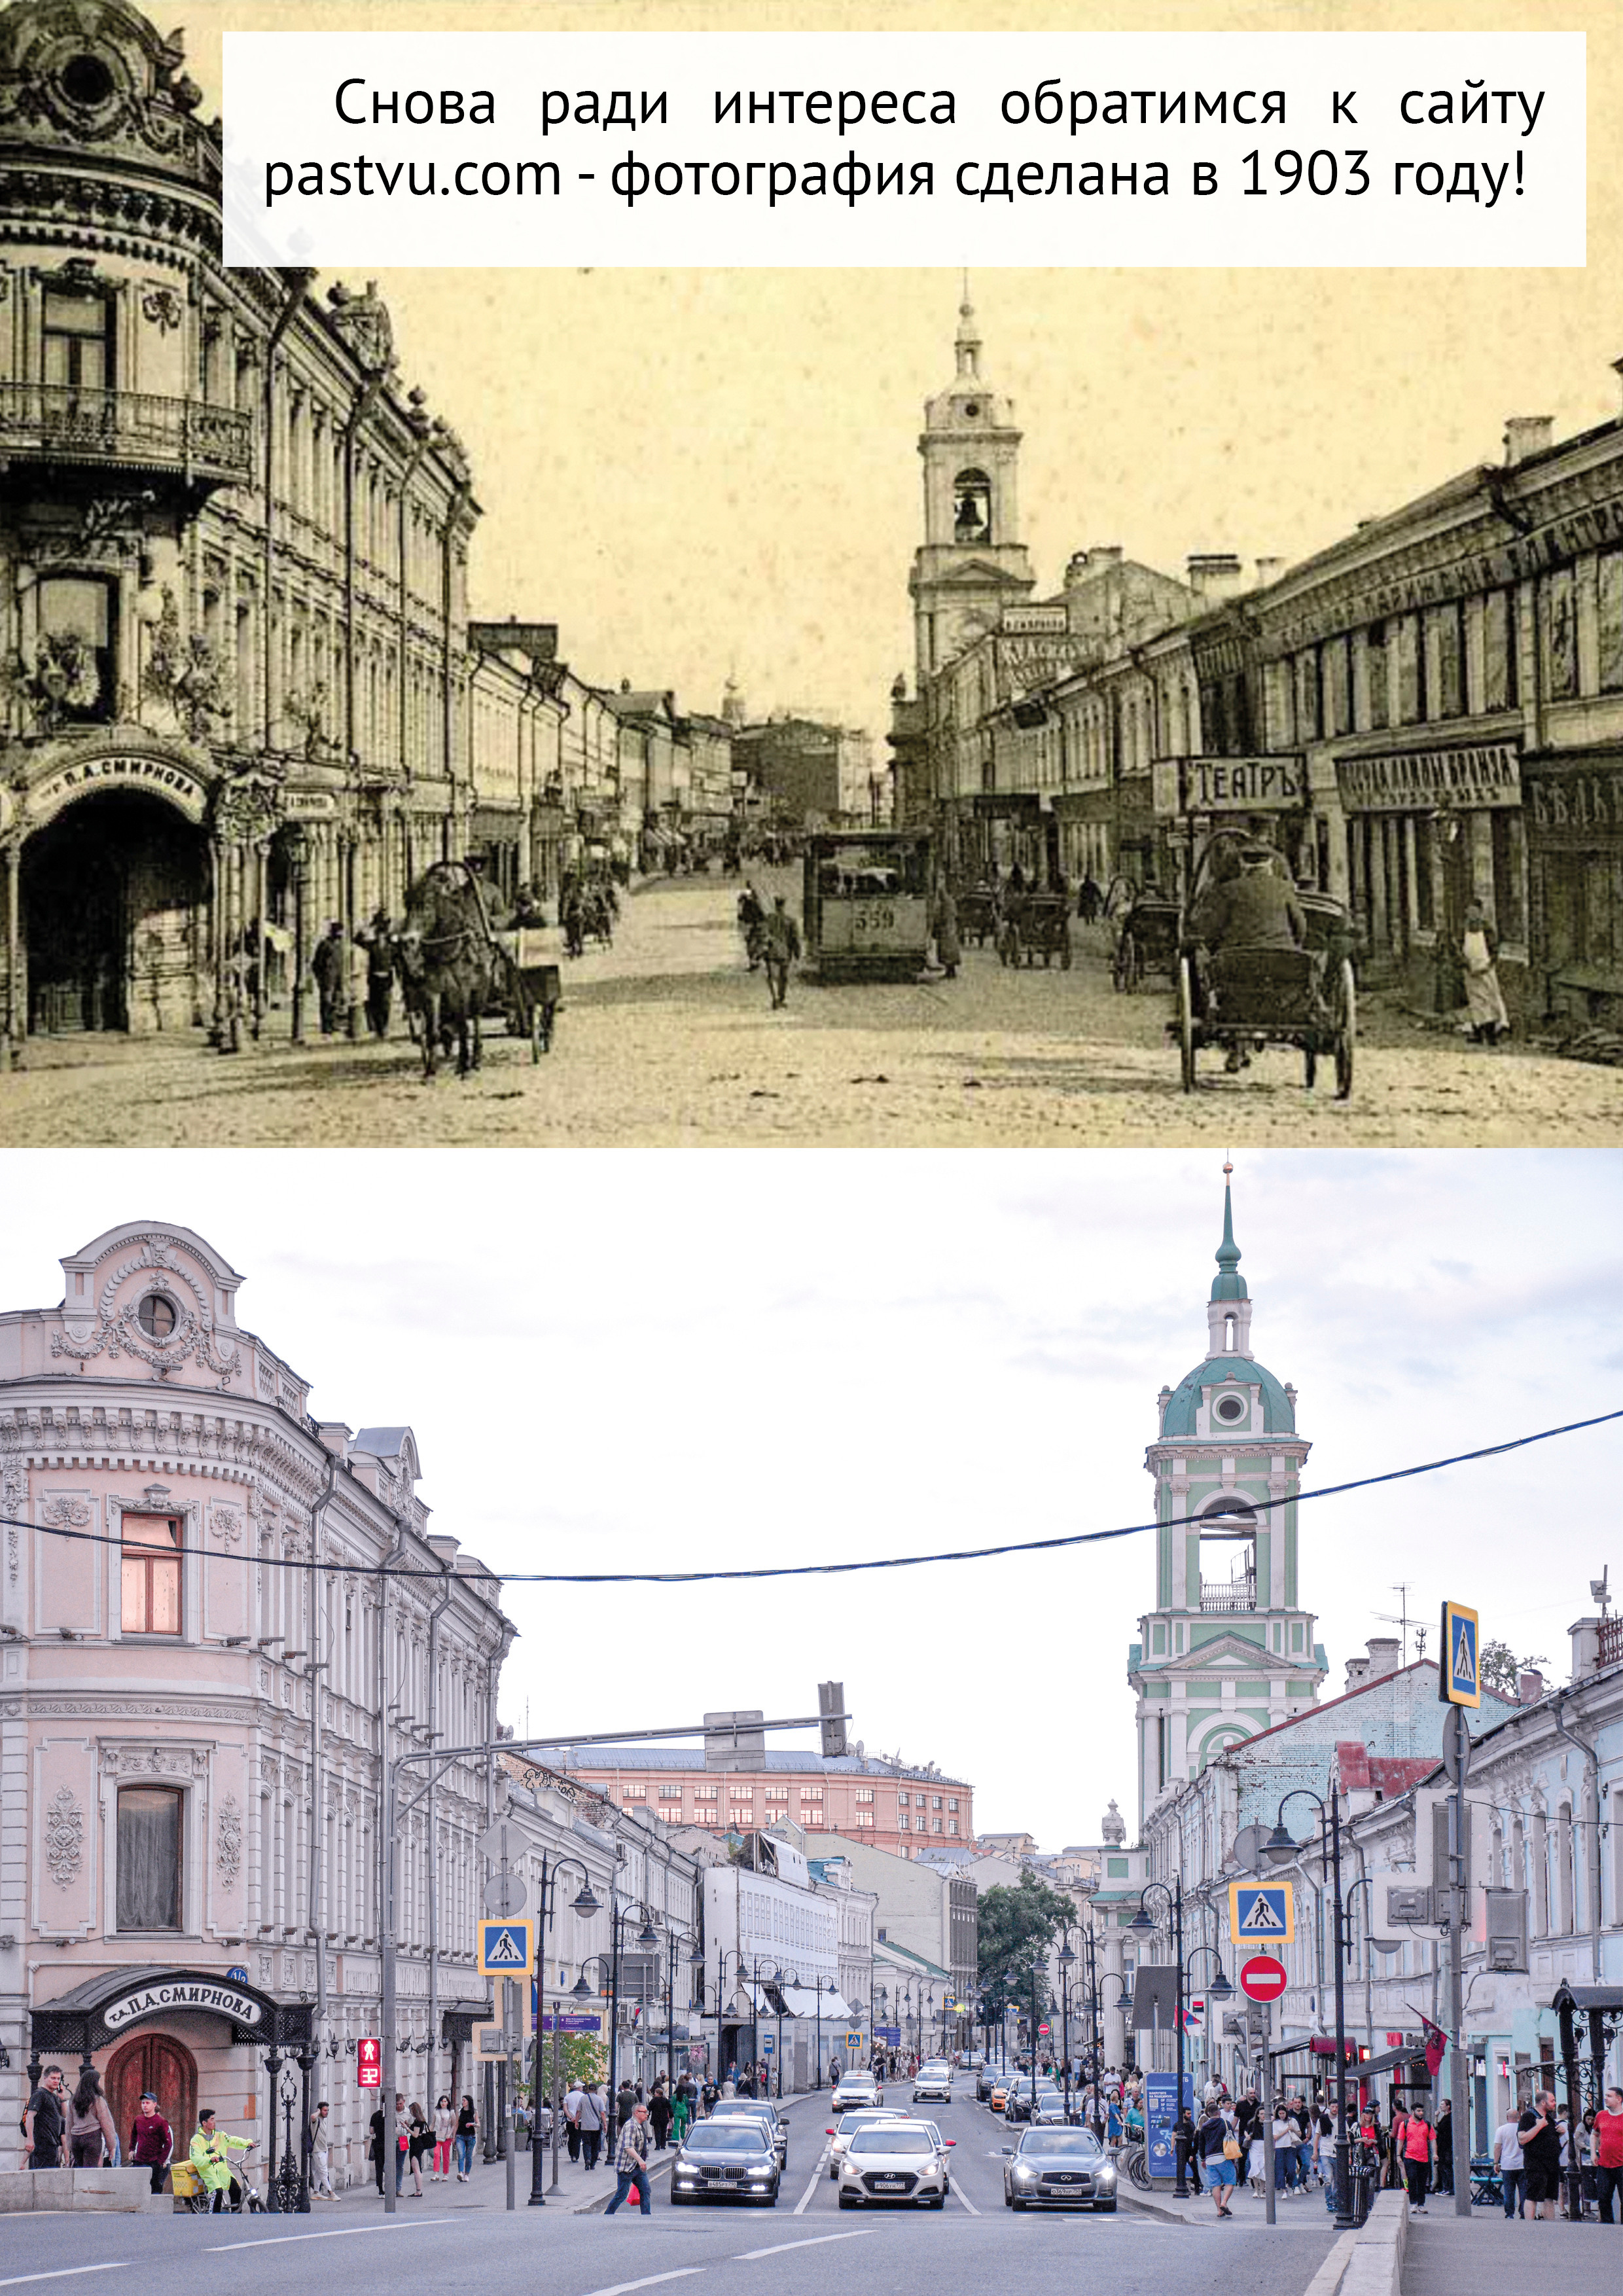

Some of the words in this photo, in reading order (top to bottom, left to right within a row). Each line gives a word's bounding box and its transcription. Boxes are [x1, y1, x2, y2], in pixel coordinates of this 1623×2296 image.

[1195, 762, 1296, 805] ТЕАТРЪ
[159, 1986, 253, 2020] СМИРНОВА
[362, 2068, 378, 2083] 32
